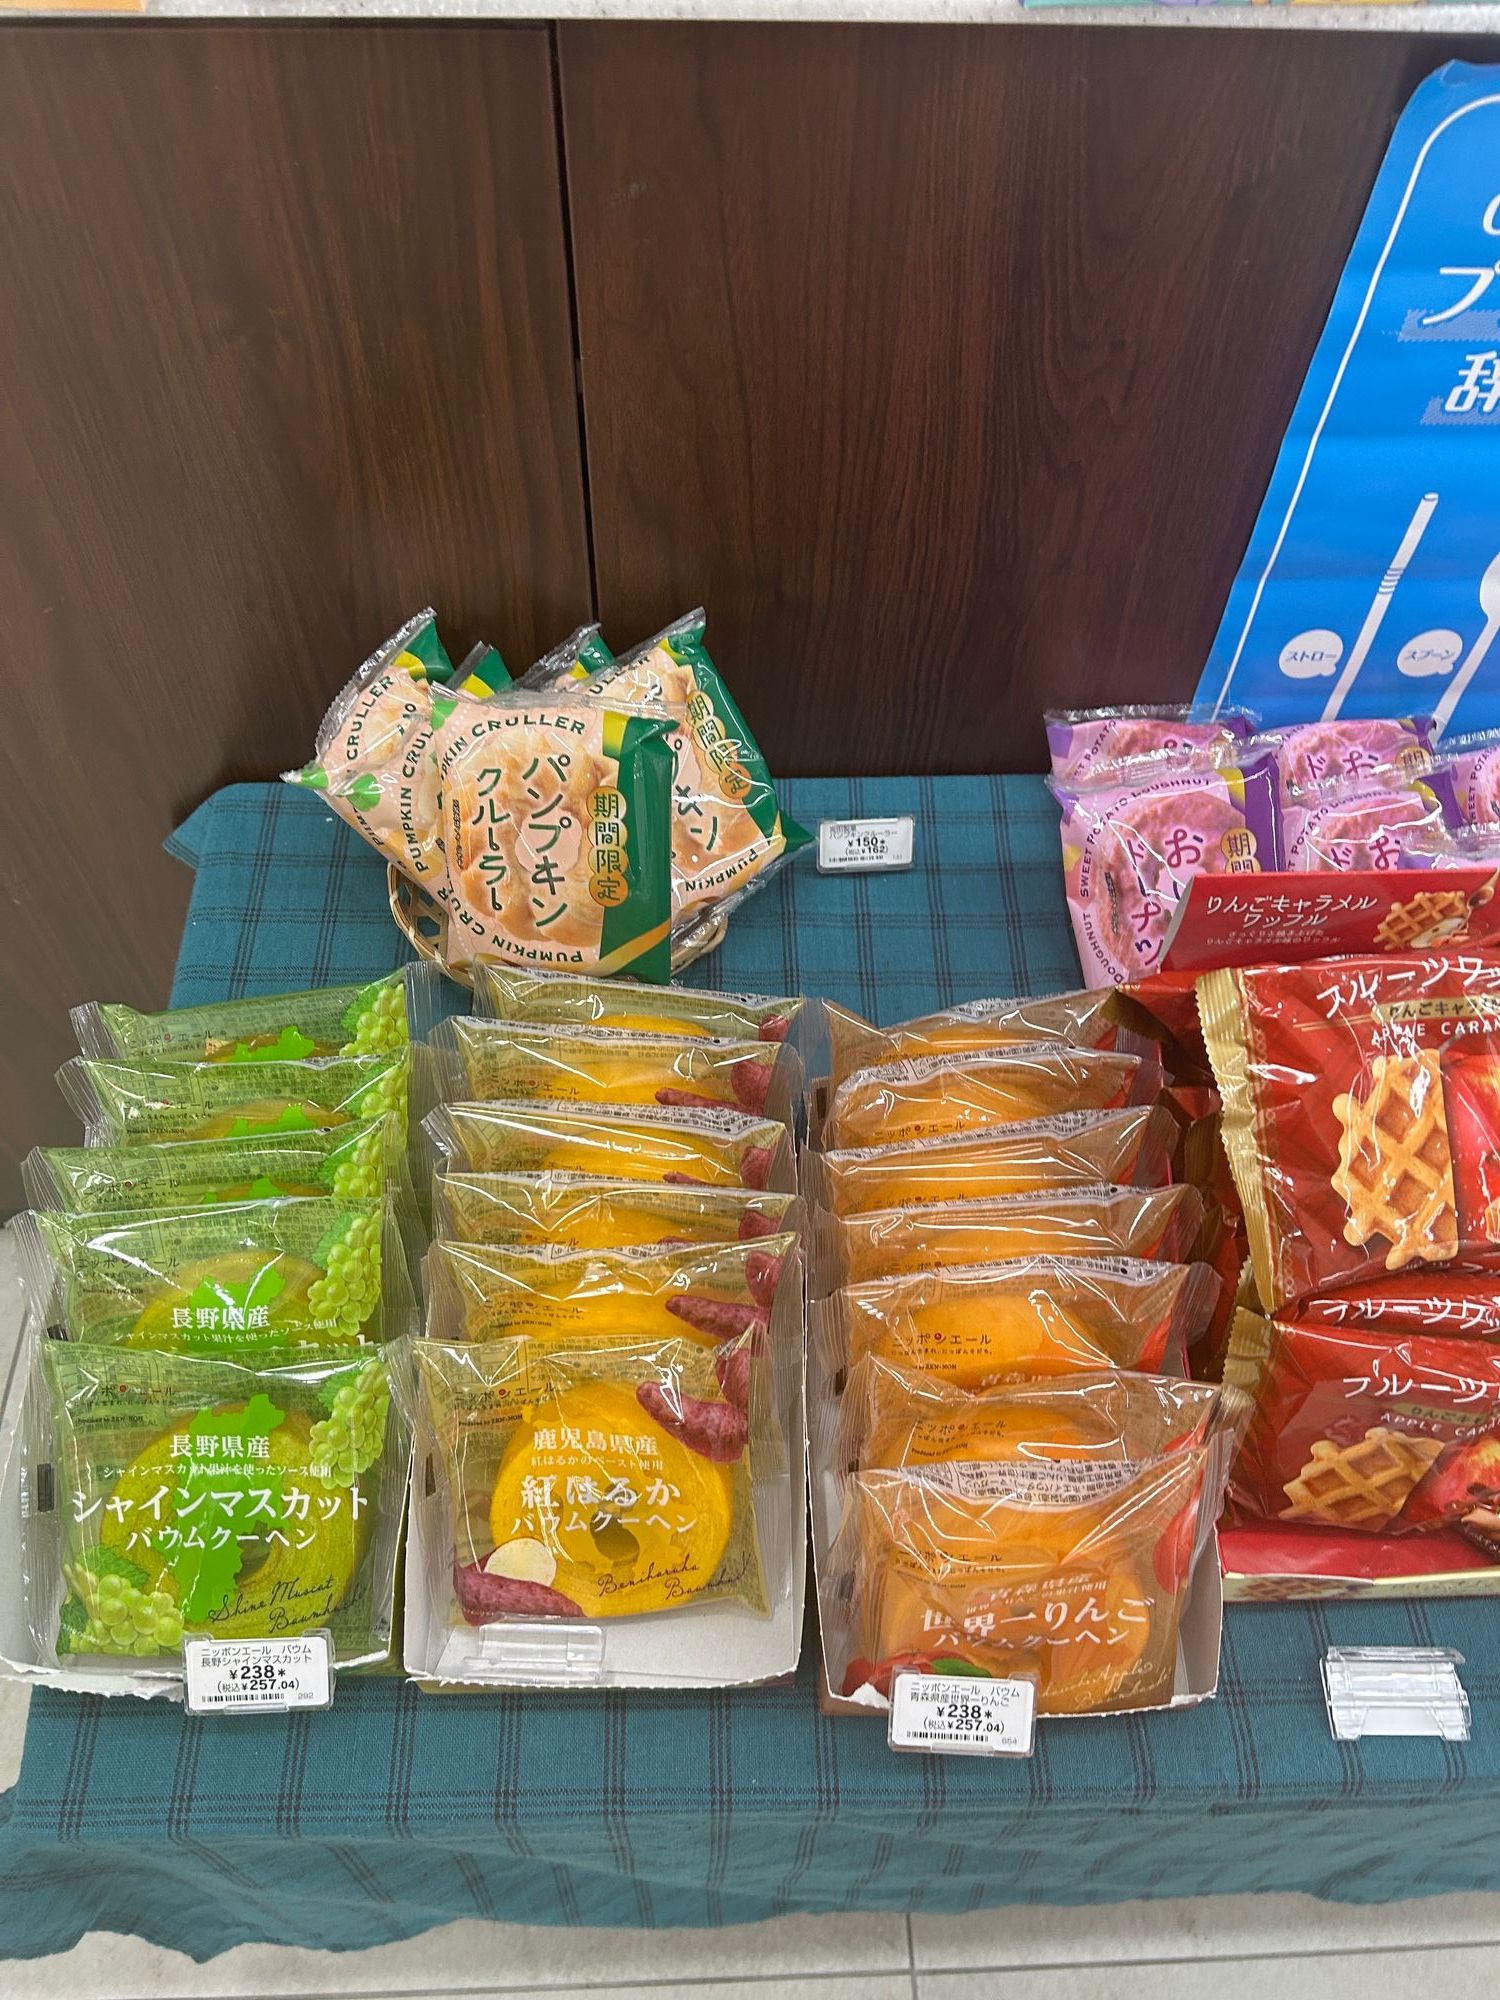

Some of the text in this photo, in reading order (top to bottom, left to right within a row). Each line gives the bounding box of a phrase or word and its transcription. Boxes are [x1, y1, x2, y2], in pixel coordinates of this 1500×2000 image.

[346, 675, 395, 762] CRULLER
[471, 714, 586, 737] CRULLER
[402, 730, 435, 778] CRUL
[400, 787, 429, 873] PUMPKIN
[476, 767, 511, 912] クルーラー
[522, 752, 572, 928] パンプキン
[592, 793, 622, 902] 期間限定
[685, 848, 759, 892] PUMPKIN
[1080, 848, 1093, 898] SWEET
[1207, 894, 1378, 914] りんごキャラメル
[1243, 913, 1328, 928] ワッフル
[492, 935, 584, 962] PUMPKIN
[1082, 912, 1125, 984] DOUGHNUT
[1316, 955, 1500, 1019] フルーツワ
[172, 1306, 271, 1330] 長野県産
[1380, 1412, 1443, 1433] APPLE
[169, 1433, 271, 1460] 長野県産
[532, 1428, 659, 1457] 鹿児島県産
[530, 1453, 665, 1471] 紅はるかのペースト使用
[71, 1485, 369, 1524] シャインマスカット
[520, 1474, 682, 1511] 紅はるか
[510, 1511, 698, 1536] バウムクーヘン
[125, 1526, 318, 1551] バウムクーヘン
[207, 1573, 335, 1623] Shine Muscat
[920, 1596, 1155, 1638] 世界一りんご
[201, 1644, 312, 1657] ニッポンエール バウム
[201, 1653, 313, 1668] 長野シャインマスカット
[910, 1681, 1020, 1698] ニッポンエール バウム
[910, 1691, 1010, 1708] 青森県産世界一りんご
